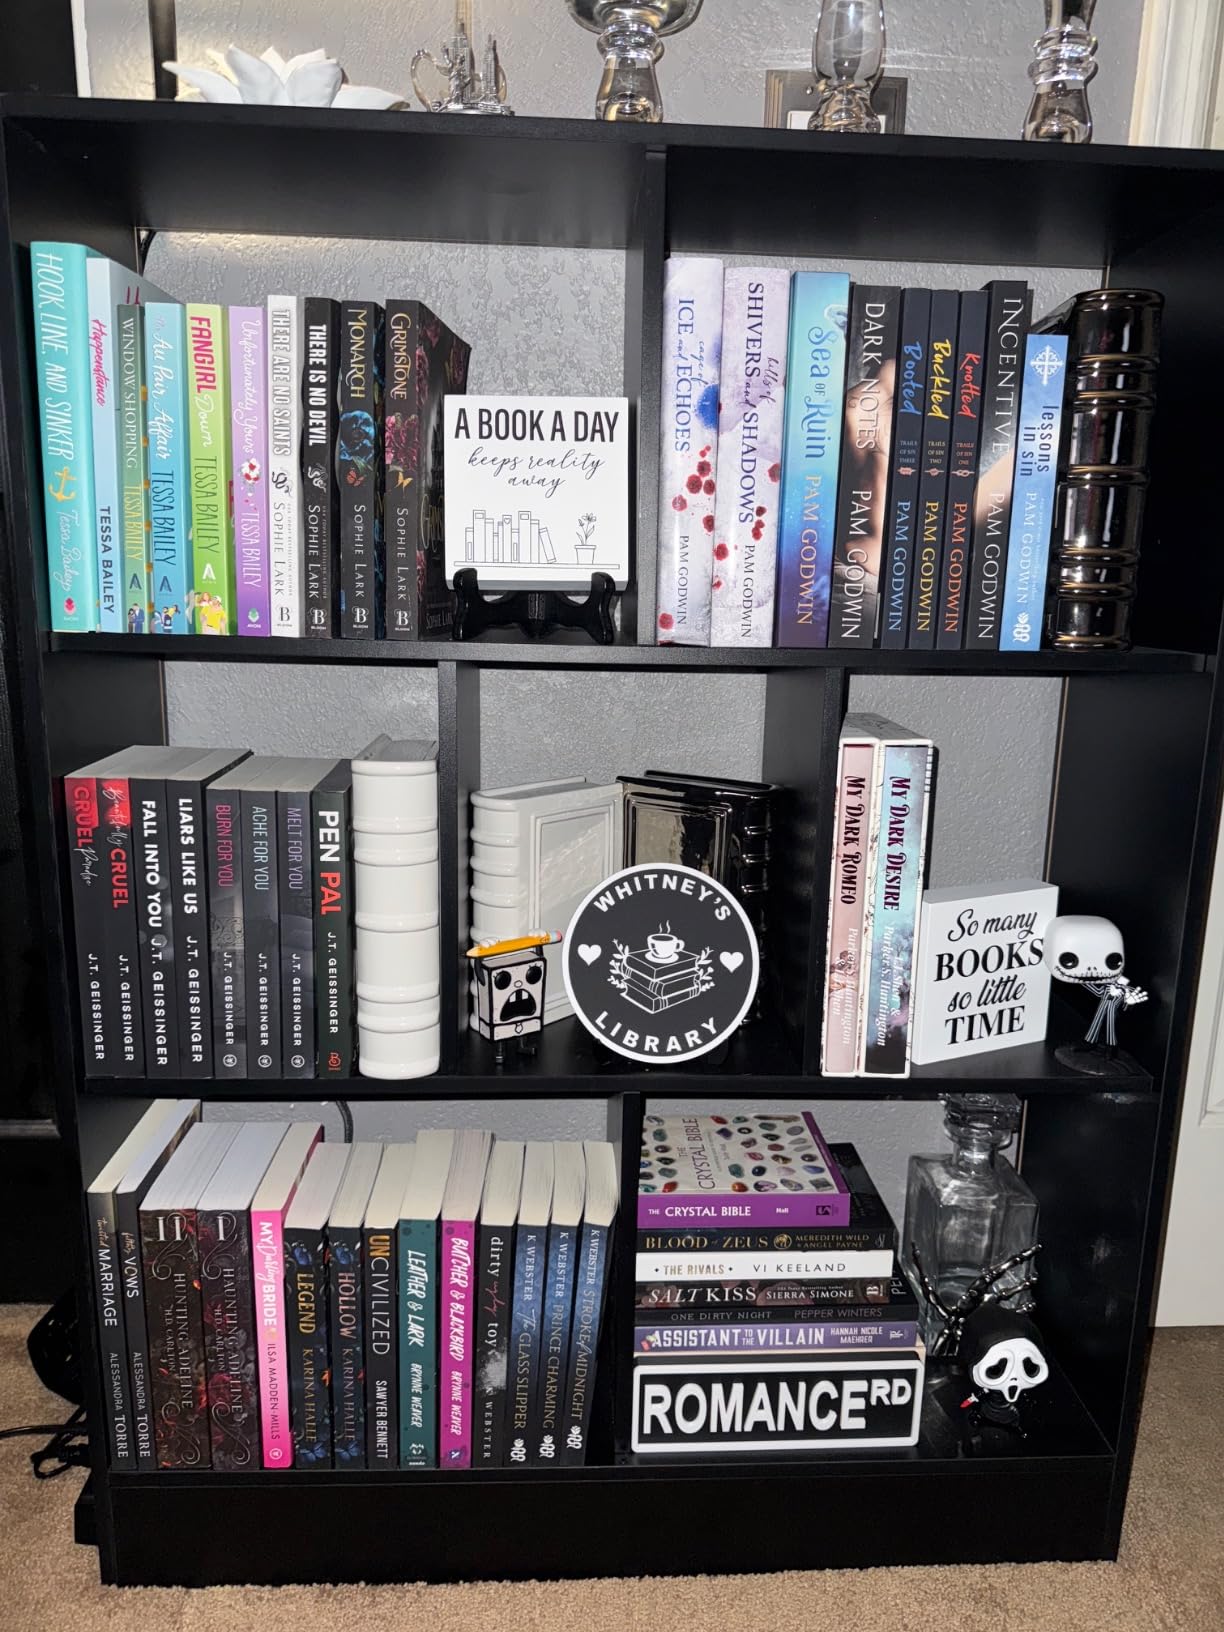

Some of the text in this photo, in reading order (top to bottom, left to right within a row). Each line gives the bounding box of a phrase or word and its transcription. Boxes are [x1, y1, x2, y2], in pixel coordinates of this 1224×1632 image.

[121, 317, 138, 469] WINDOW SHOPPING
[190, 316, 216, 448] FANGIRL Down
[272, 309, 291, 456] THERE ARE NO SAINTS
[309, 324, 326, 446] THERE IS NO DEVIL
[346, 308, 367, 399] MONARCH
[390, 312, 411, 400] GRIMSTONE
[674, 299, 694, 452] ICE and ECHOES
[855, 302, 886, 450] DARK NOTES
[899, 341, 923, 416] Booted
[927, 339, 952, 420] Buckled
[957, 352, 981, 420] Knotted
[992, 298, 1024, 453] INCENTIVE
[454, 407, 619, 442] A BOOK A DAY
[739, 282, 764, 524] SHIVERS and SHADOWS
[467, 446, 605, 480] keeps reality
[507, 474, 566, 498] away
[56, 510, 80, 545] Tessa
[100, 506, 115, 613] TESSA BAILEY
[124, 485, 143, 560] TESSA BAILEY
[273, 502, 286, 596] SOPHIE LARK
[308, 504, 321, 599] SOPHIE LARK
[797, 475, 822, 625] PAM GODWIN
[53, 546, 81, 592] Bailey
[677, 535, 690, 625] PAM GODWIN
[741, 545, 756, 638] PAM GODWIN
[142, 800, 163, 928] FALL INTO YOU
[178, 798, 198, 914] LIARS LIKE US
[215, 804, 234, 888] BURN FOR YOU
[252, 806, 270, 890] ACHE FOR YOU
[287, 807, 304, 890] MELT FOR YOU
[318, 811, 342, 916] PEN PAL
[840, 775, 866, 905] MY DARK ROMEO
[883, 776, 911, 911] MY DARK DESIRE
[593, 874, 732, 921] WHITNEY'S
[947, 908, 1038, 942] So many
[933, 938, 1044, 982] BOOKS
[947, 974, 1027, 1013] so little
[119, 954, 134, 1061] J.T. GEISSINGER
[594, 1011, 718, 1053] LIBRARY
[944, 1005, 1026, 1046] TIME
[678, 1145, 688, 1158] THE
[681, 1117, 703, 1142] BIBLE
[690, 1143, 716, 1191] CRYSTAL
[665, 1206, 718, 1217] CRYSTAL
[721, 1206, 752, 1217] BIBLE
[256, 1222, 280, 1326] MY Darling BRIDE
[369, 1235, 390, 1355] UNCIVILIZED
[523, 1234, 536, 1301] K WEBSTER
[555, 1231, 569, 1298] K WEBSTER
[586, 1229, 600, 1286] K WEBSTER
[648, 1287, 757, 1303] SALT KISS
[663, 1264, 725, 1275] THE RIVALS
[753, 1263, 846, 1273] VI KEELAND
[766, 1289, 854, 1299] SIERRA SIMONE
[296, 1273, 316, 1334] LEGEND
[338, 1272, 357, 1340] HOLLOW
[406, 1250, 429, 1348] LEATHER & LARK
[449, 1237, 471, 1361] BUTCHER & BLACKBIRD
[651, 1329, 741, 1348] ASSISTANT
[671, 1311, 772, 1321] ONE DIRTY NIGHT
[744, 1329, 753, 1337] TO
[757, 1328, 825, 1346] VILLAIN
[794, 1308, 882, 1319] PEPPER WINTERS
[830, 1326, 883, 1335] HANNAH NICOLE
[840, 1335, 873, 1344] MAEHRER
[173, 1273, 194, 1409] HUNTING ADELINE
[222, 1268, 243, 1413] HAUNTING ADELINE
[542, 1303, 565, 1429] PRINCE CHARMING
[109, 1352, 129, 1458] ALESSANDRA TORRE
[133, 1352, 151, 1457] ALESSANDRA TORRE
[267, 1343, 280, 1440] ILSA MADDEN-MILLS
[303, 1348, 317, 1442] KARINA HALLE
[375, 1380, 389, 1459] SAWYER BENNETT
[643, 1378, 912, 1435] ROMANCE RD
